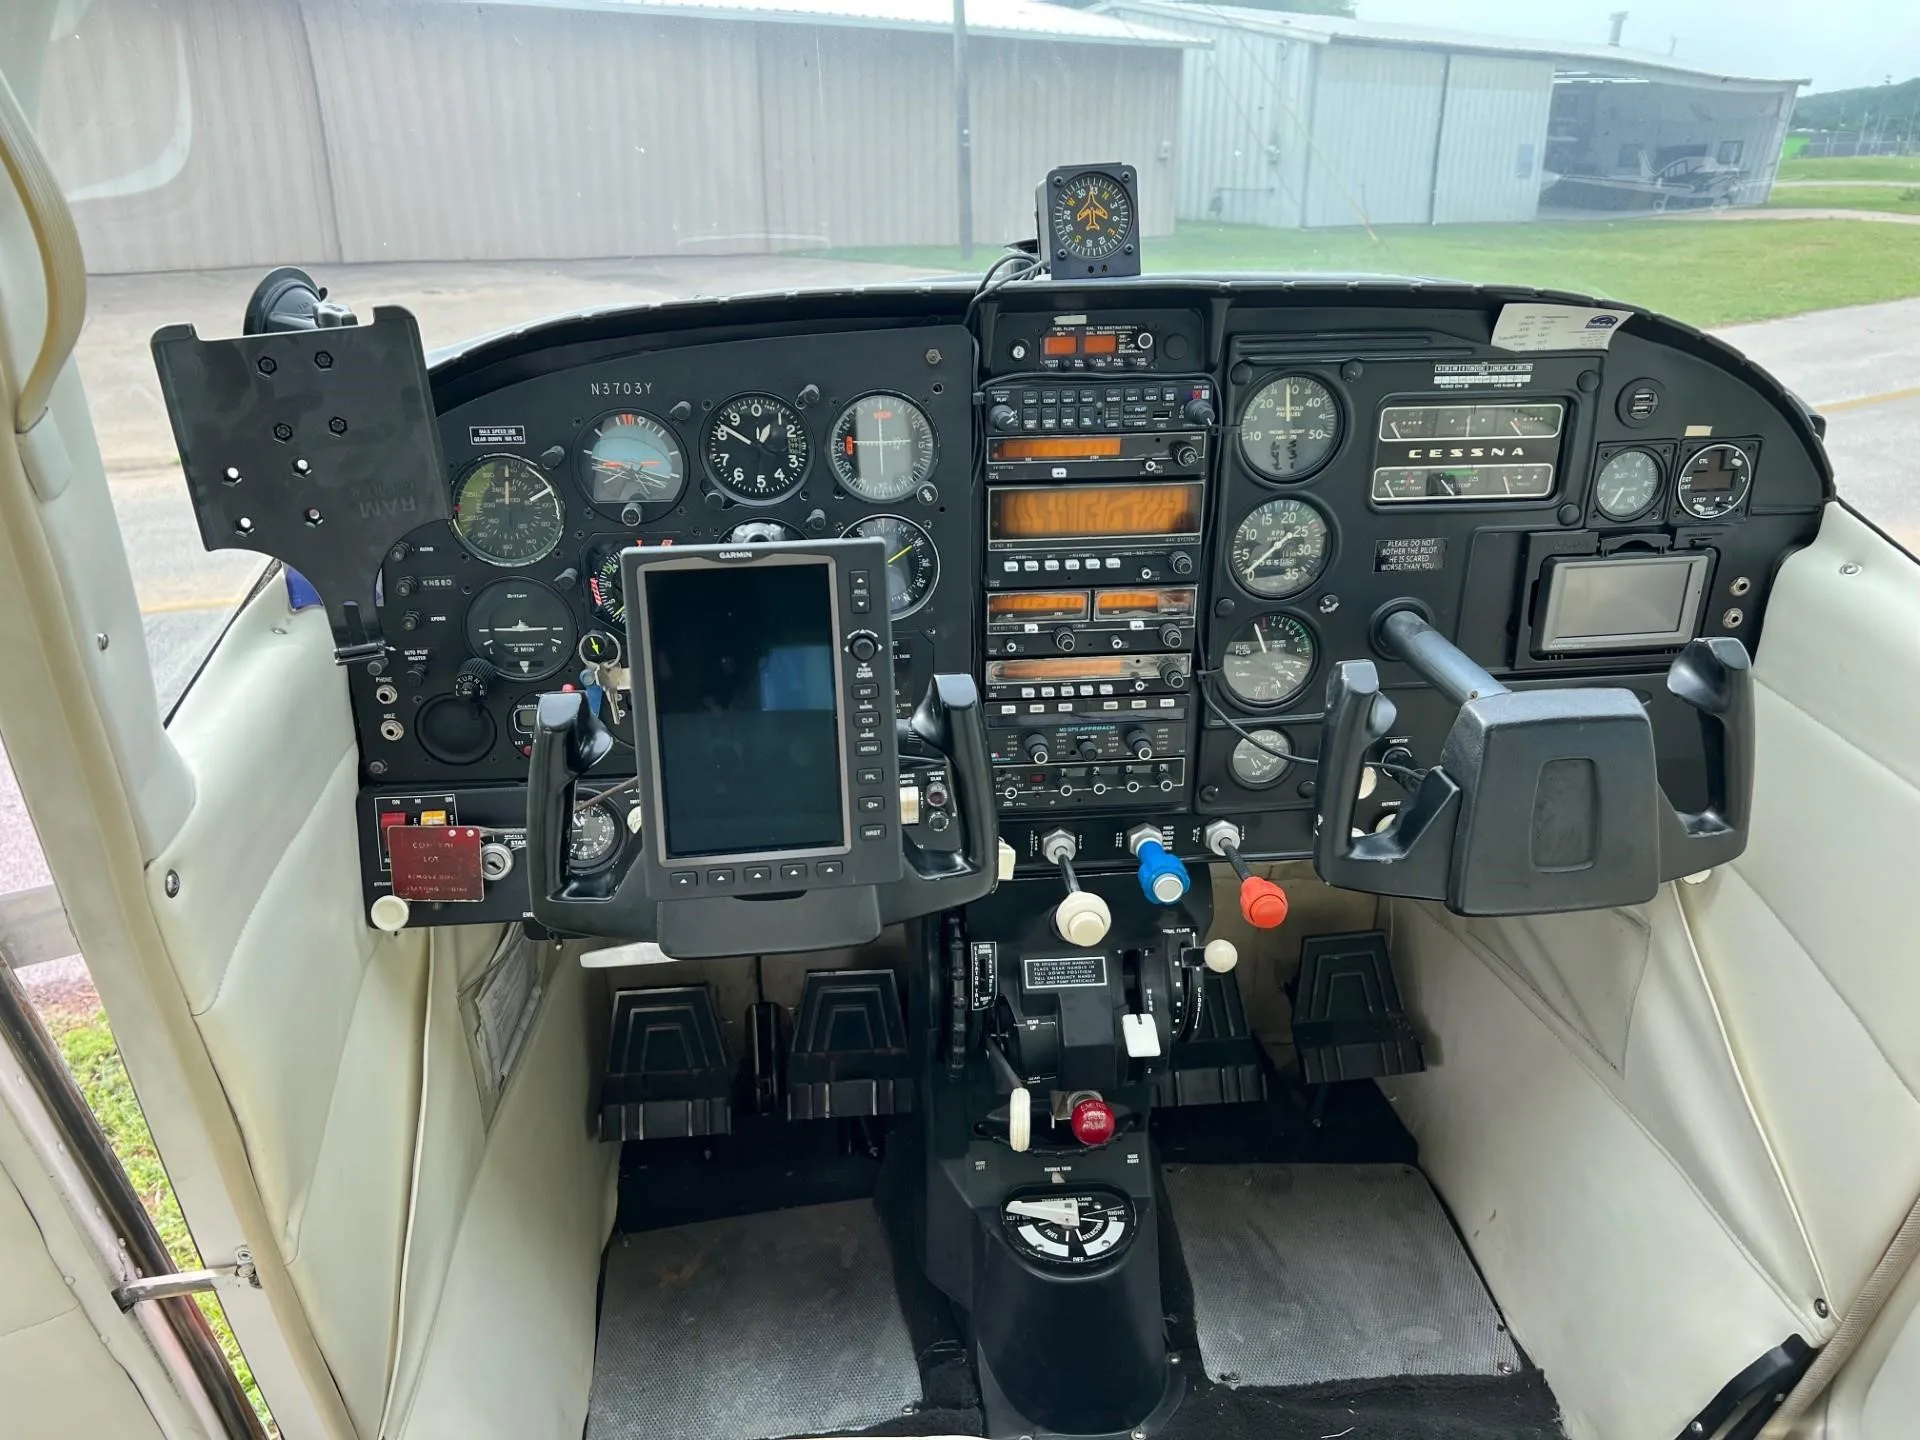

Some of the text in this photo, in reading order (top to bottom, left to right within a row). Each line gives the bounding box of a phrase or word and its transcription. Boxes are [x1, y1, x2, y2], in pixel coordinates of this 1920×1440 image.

[591, 383, 652, 396] N3703Y
[1260, 398, 1274, 409] 20
[1306, 398, 1321, 408] 40
[751, 403, 762, 417] 0
[730, 412, 740, 426] 9
[717, 427, 727, 441] 8
[786, 424, 796, 437] 2
[1250, 431, 1262, 441] 10
[1308, 430, 1323, 440] 50
[1408, 447, 1525, 459] CESSNA
[720, 453, 730, 466] 7
[788, 454, 799, 468] 3
[733, 467, 744, 481] 6
[774, 468, 785, 481] 4
[756, 474, 766, 488] 5
[359, 496, 416, 518] RAM
[1261, 513, 1273, 526] 15
[1281, 512, 1297, 524] 20
[1245, 529, 1257, 541] 10
[1293, 525, 1309, 537] 25
[1387, 539, 1409, 548] PLEASE
[1421, 539, 1435, 547] NOT
[719, 551, 752, 559] GARMIN
[1242, 548, 1250, 560] 5
[1296, 544, 1312, 556] 30
[1382, 547, 1406, 556] BOTHER
[1407, 547, 1419, 555] THE
[1406, 554, 1430, 563] SCARED
[1381, 563, 1402, 571] WORSE
[1402, 562, 1421, 571] THAN
[1247, 570, 1255, 581] 0
[1283, 568, 1299, 580] 35
[456, 674, 481, 684] TURN
[1044, 1221, 1104, 1241] FUEL SELECTOR
